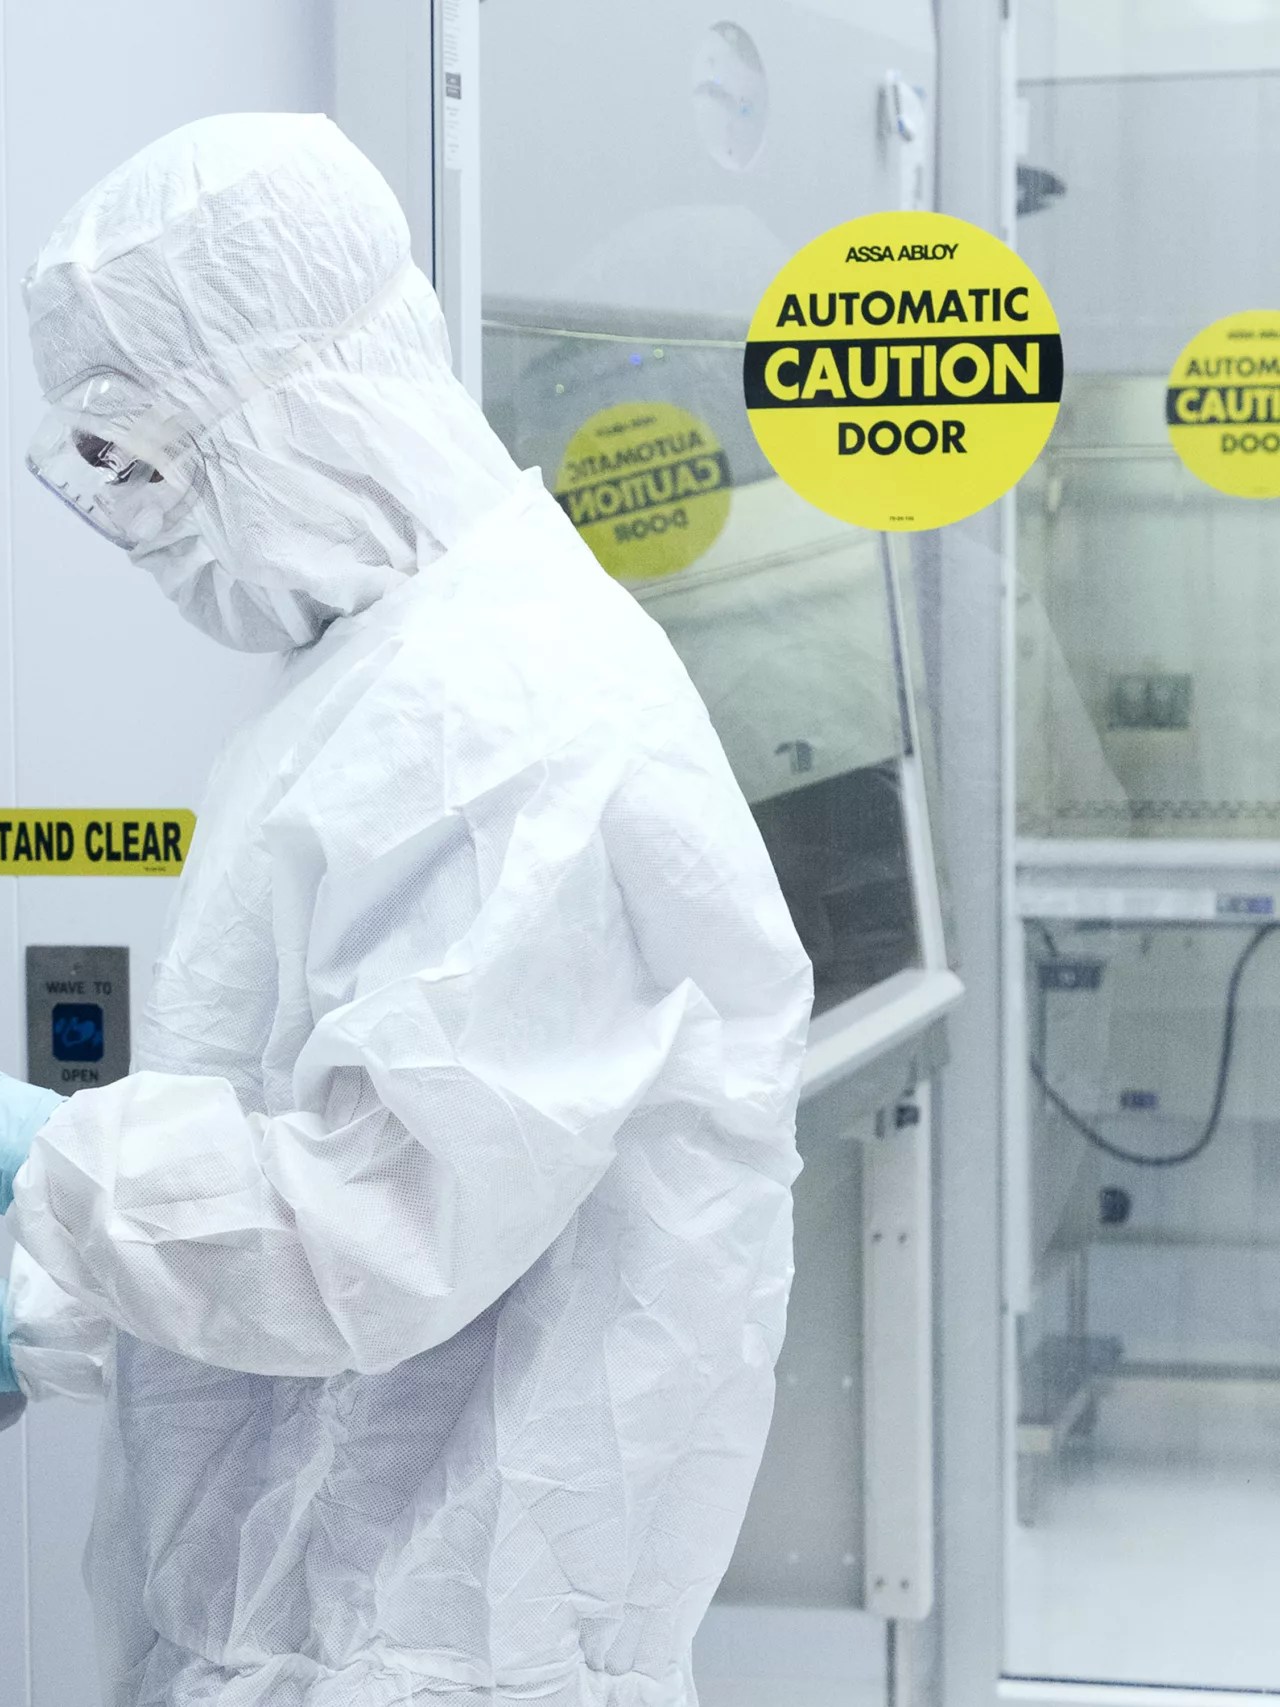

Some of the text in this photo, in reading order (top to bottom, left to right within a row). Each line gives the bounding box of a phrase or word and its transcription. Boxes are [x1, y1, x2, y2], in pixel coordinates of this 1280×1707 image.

[845, 243, 959, 263] ASSA ABLOY
[776, 286, 1029, 328] AUTOMATIC
[764, 342, 1040, 401] CAUTION
[1186, 357, 1280, 378] AUTOM
[838, 420, 968, 456] DOOR
[85, 821, 183, 862] CLEAR
[46, 981, 113, 995] WAVE TO
[62, 1069, 99, 1083] OPEN
